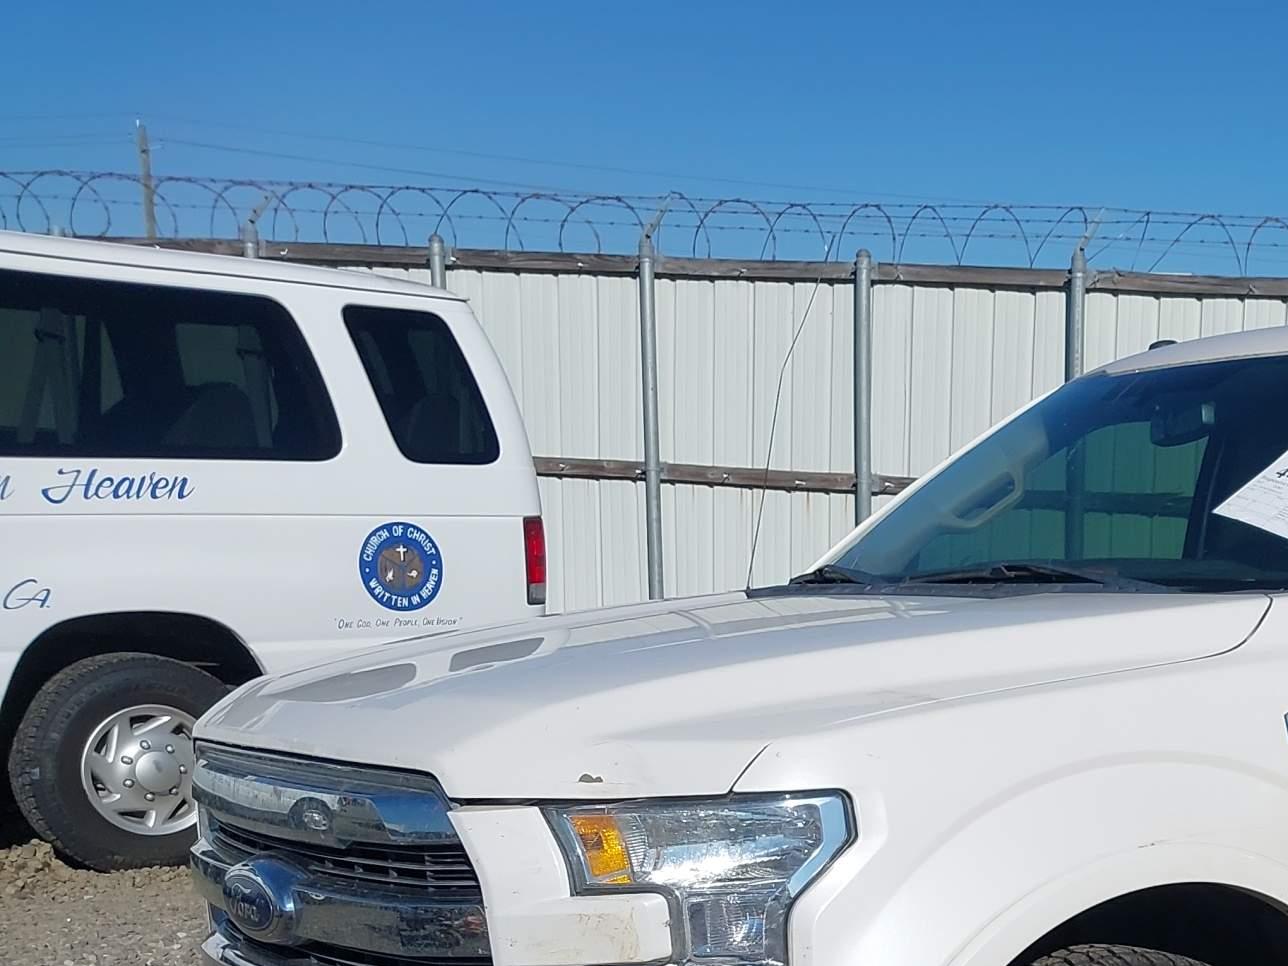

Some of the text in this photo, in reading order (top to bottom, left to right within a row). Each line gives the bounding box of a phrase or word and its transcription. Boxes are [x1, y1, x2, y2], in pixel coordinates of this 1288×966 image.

[41, 468, 195, 504] Heaven
[363, 525, 436, 562] CHURCH OF CHRIST
[368, 568, 439, 607] WRITTEN IN HEAVEN
